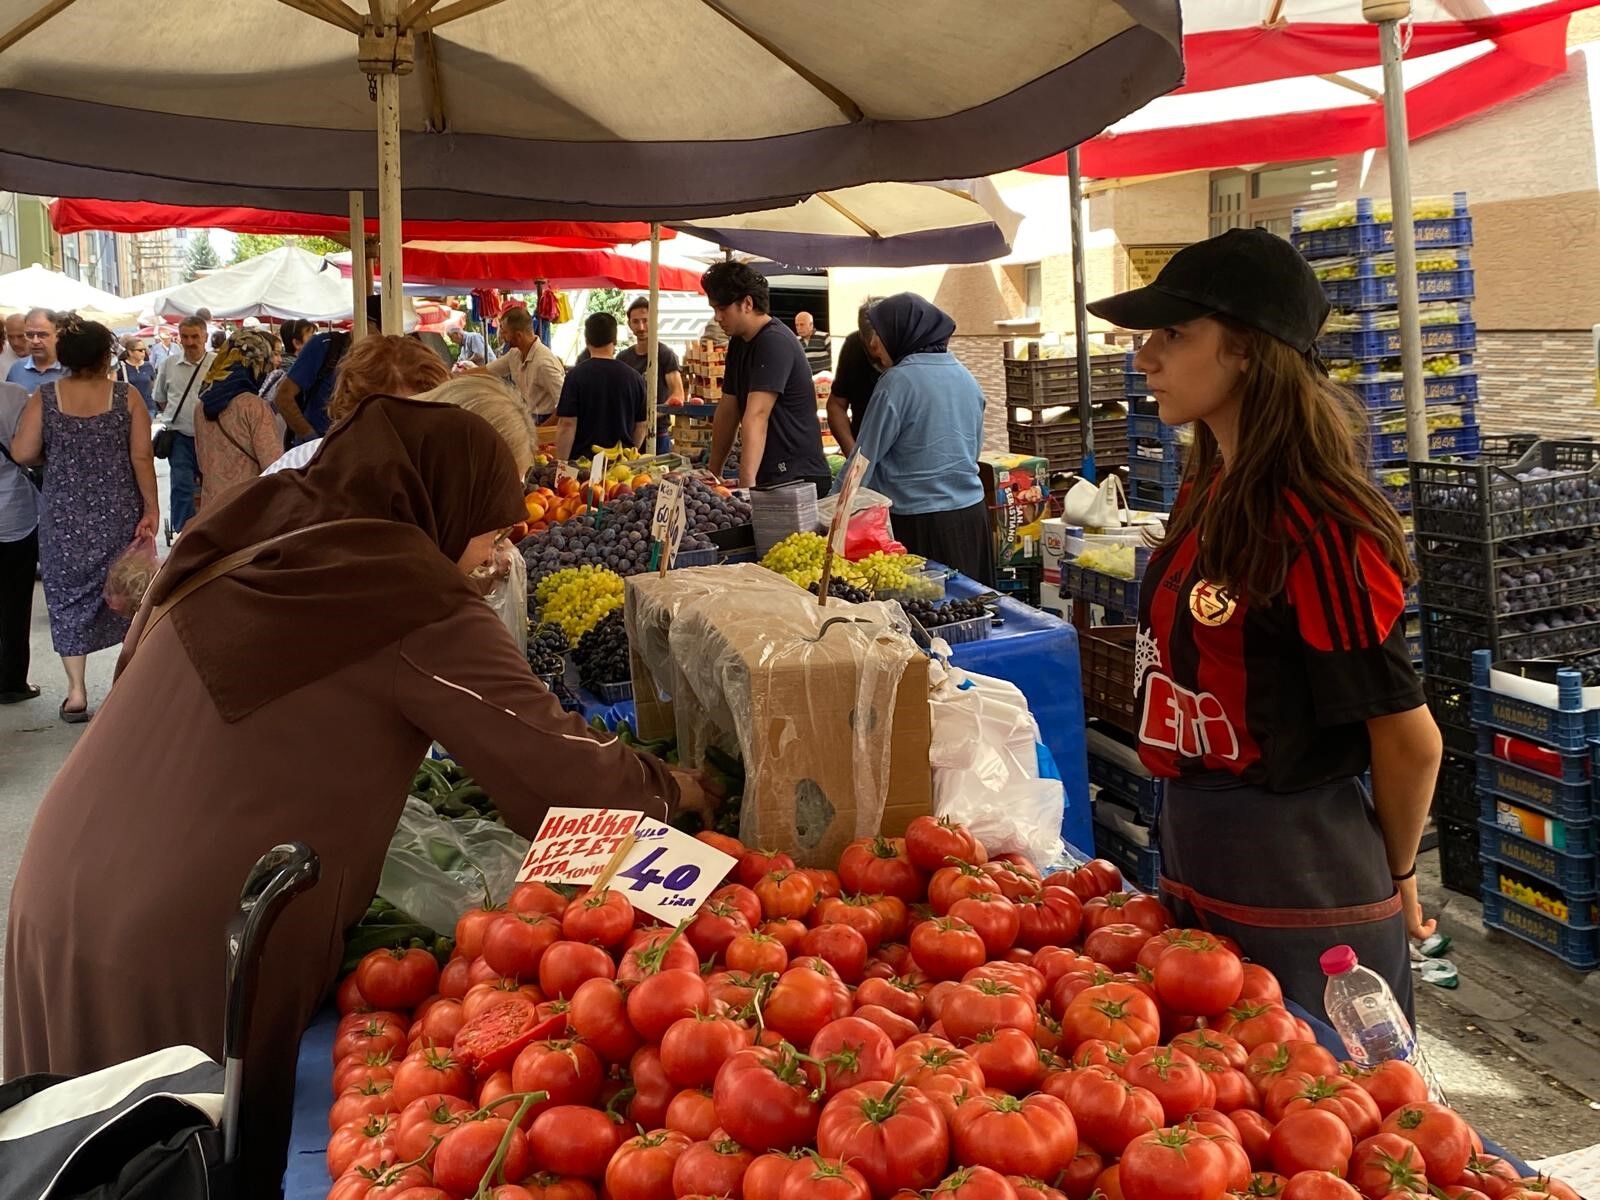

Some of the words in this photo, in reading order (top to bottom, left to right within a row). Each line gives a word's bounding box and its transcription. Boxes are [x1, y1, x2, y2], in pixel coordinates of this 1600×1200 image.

[522, 836, 625, 870] LEZZET
[616, 846, 701, 892] 40
[524, 860, 570, 881] ATA
